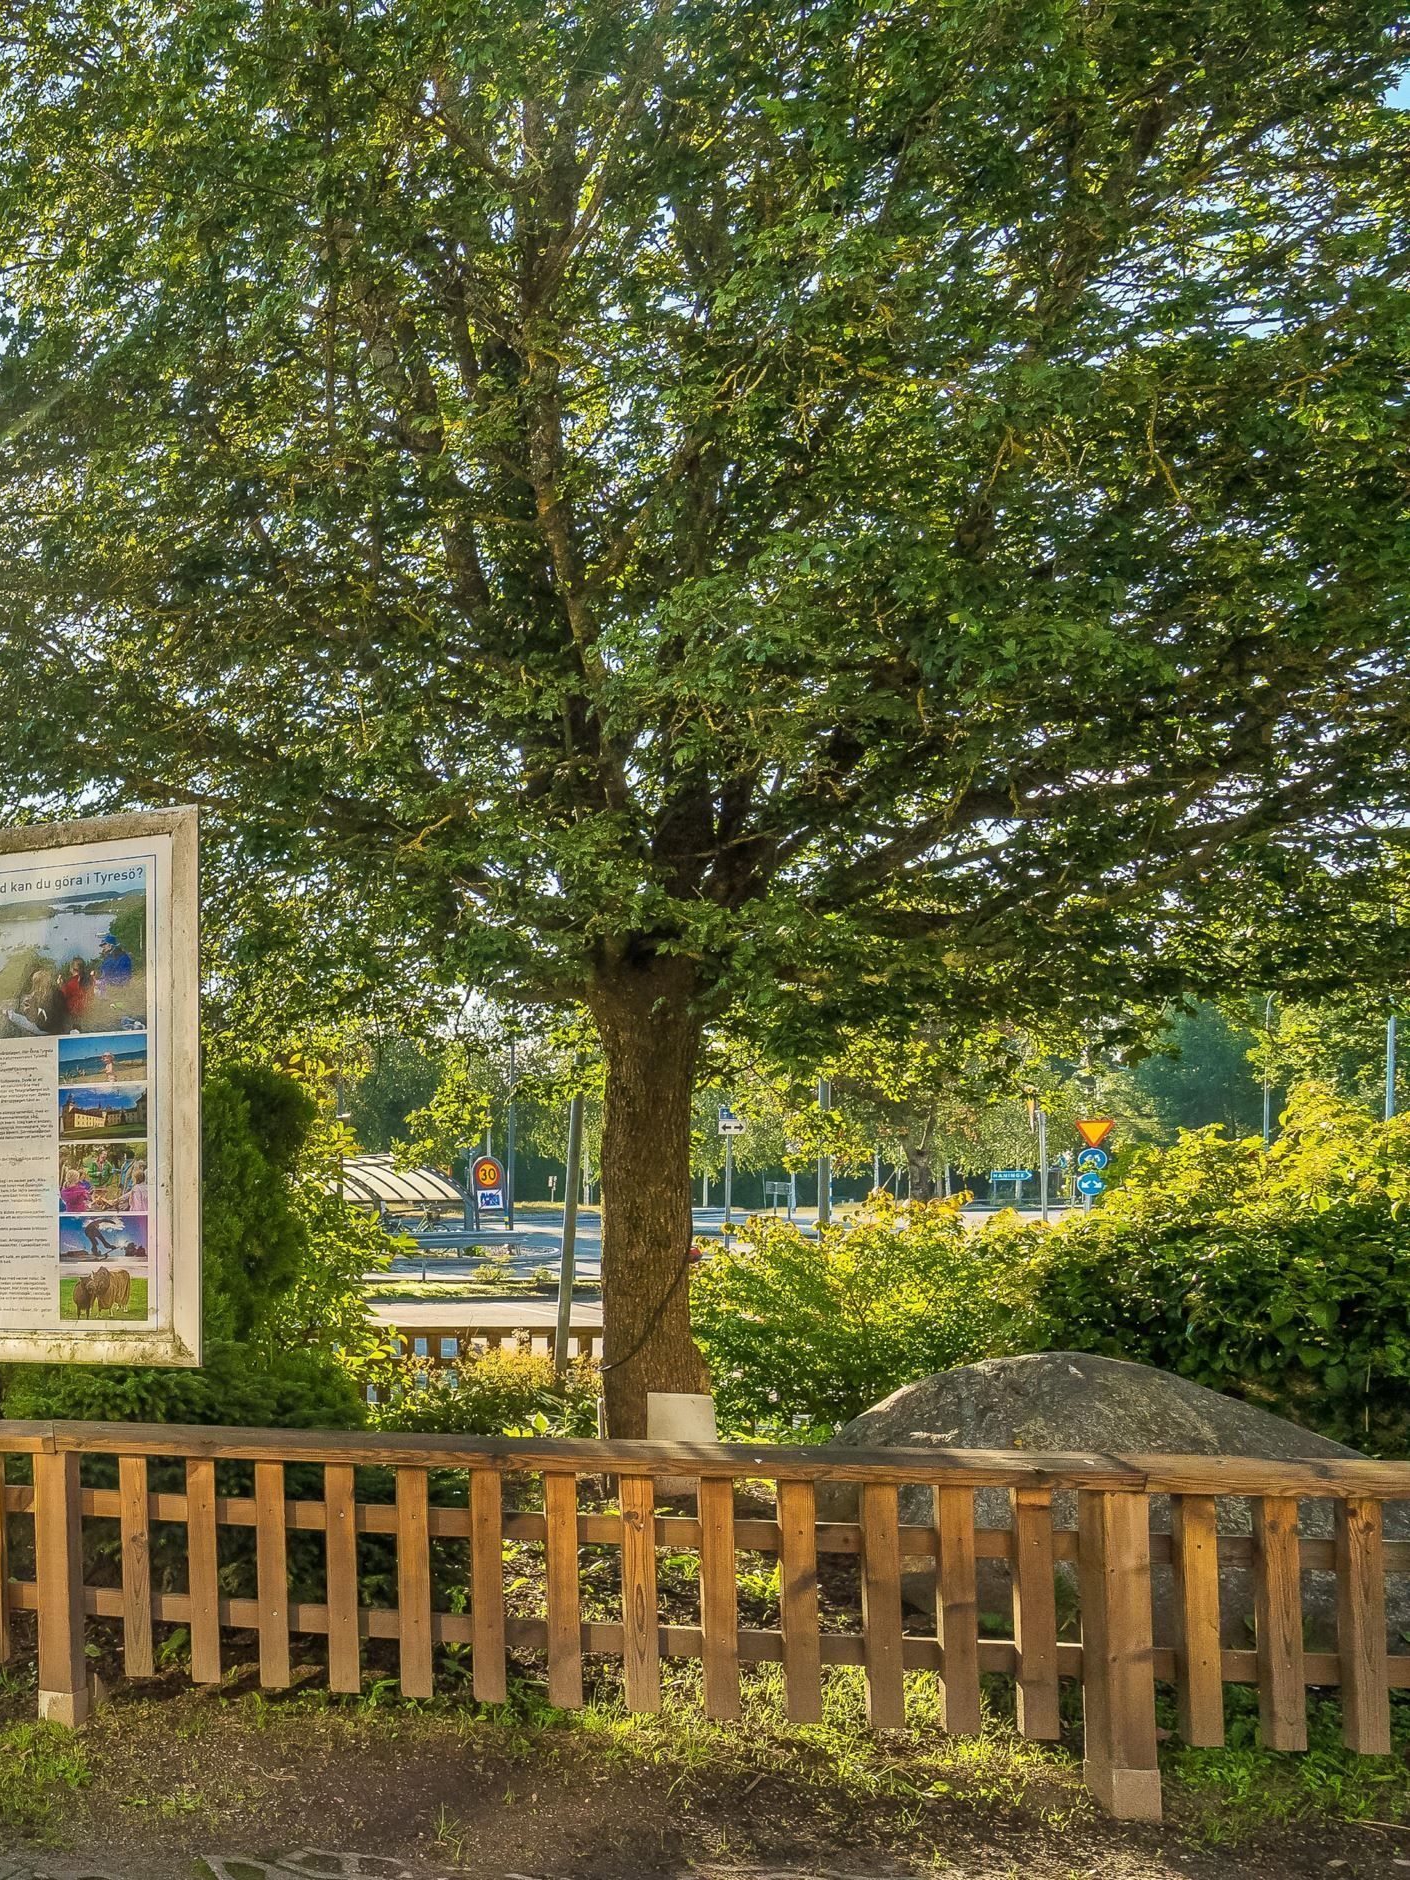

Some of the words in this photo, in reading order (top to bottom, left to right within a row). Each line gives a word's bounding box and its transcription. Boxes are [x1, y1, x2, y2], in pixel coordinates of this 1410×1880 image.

[10, 880, 32, 892] kan
[36, 879, 51, 890] du
[54, 875, 83, 890] göra
[93, 867, 144, 885] Tyresö?
[480, 1168, 497, 1181] 30
